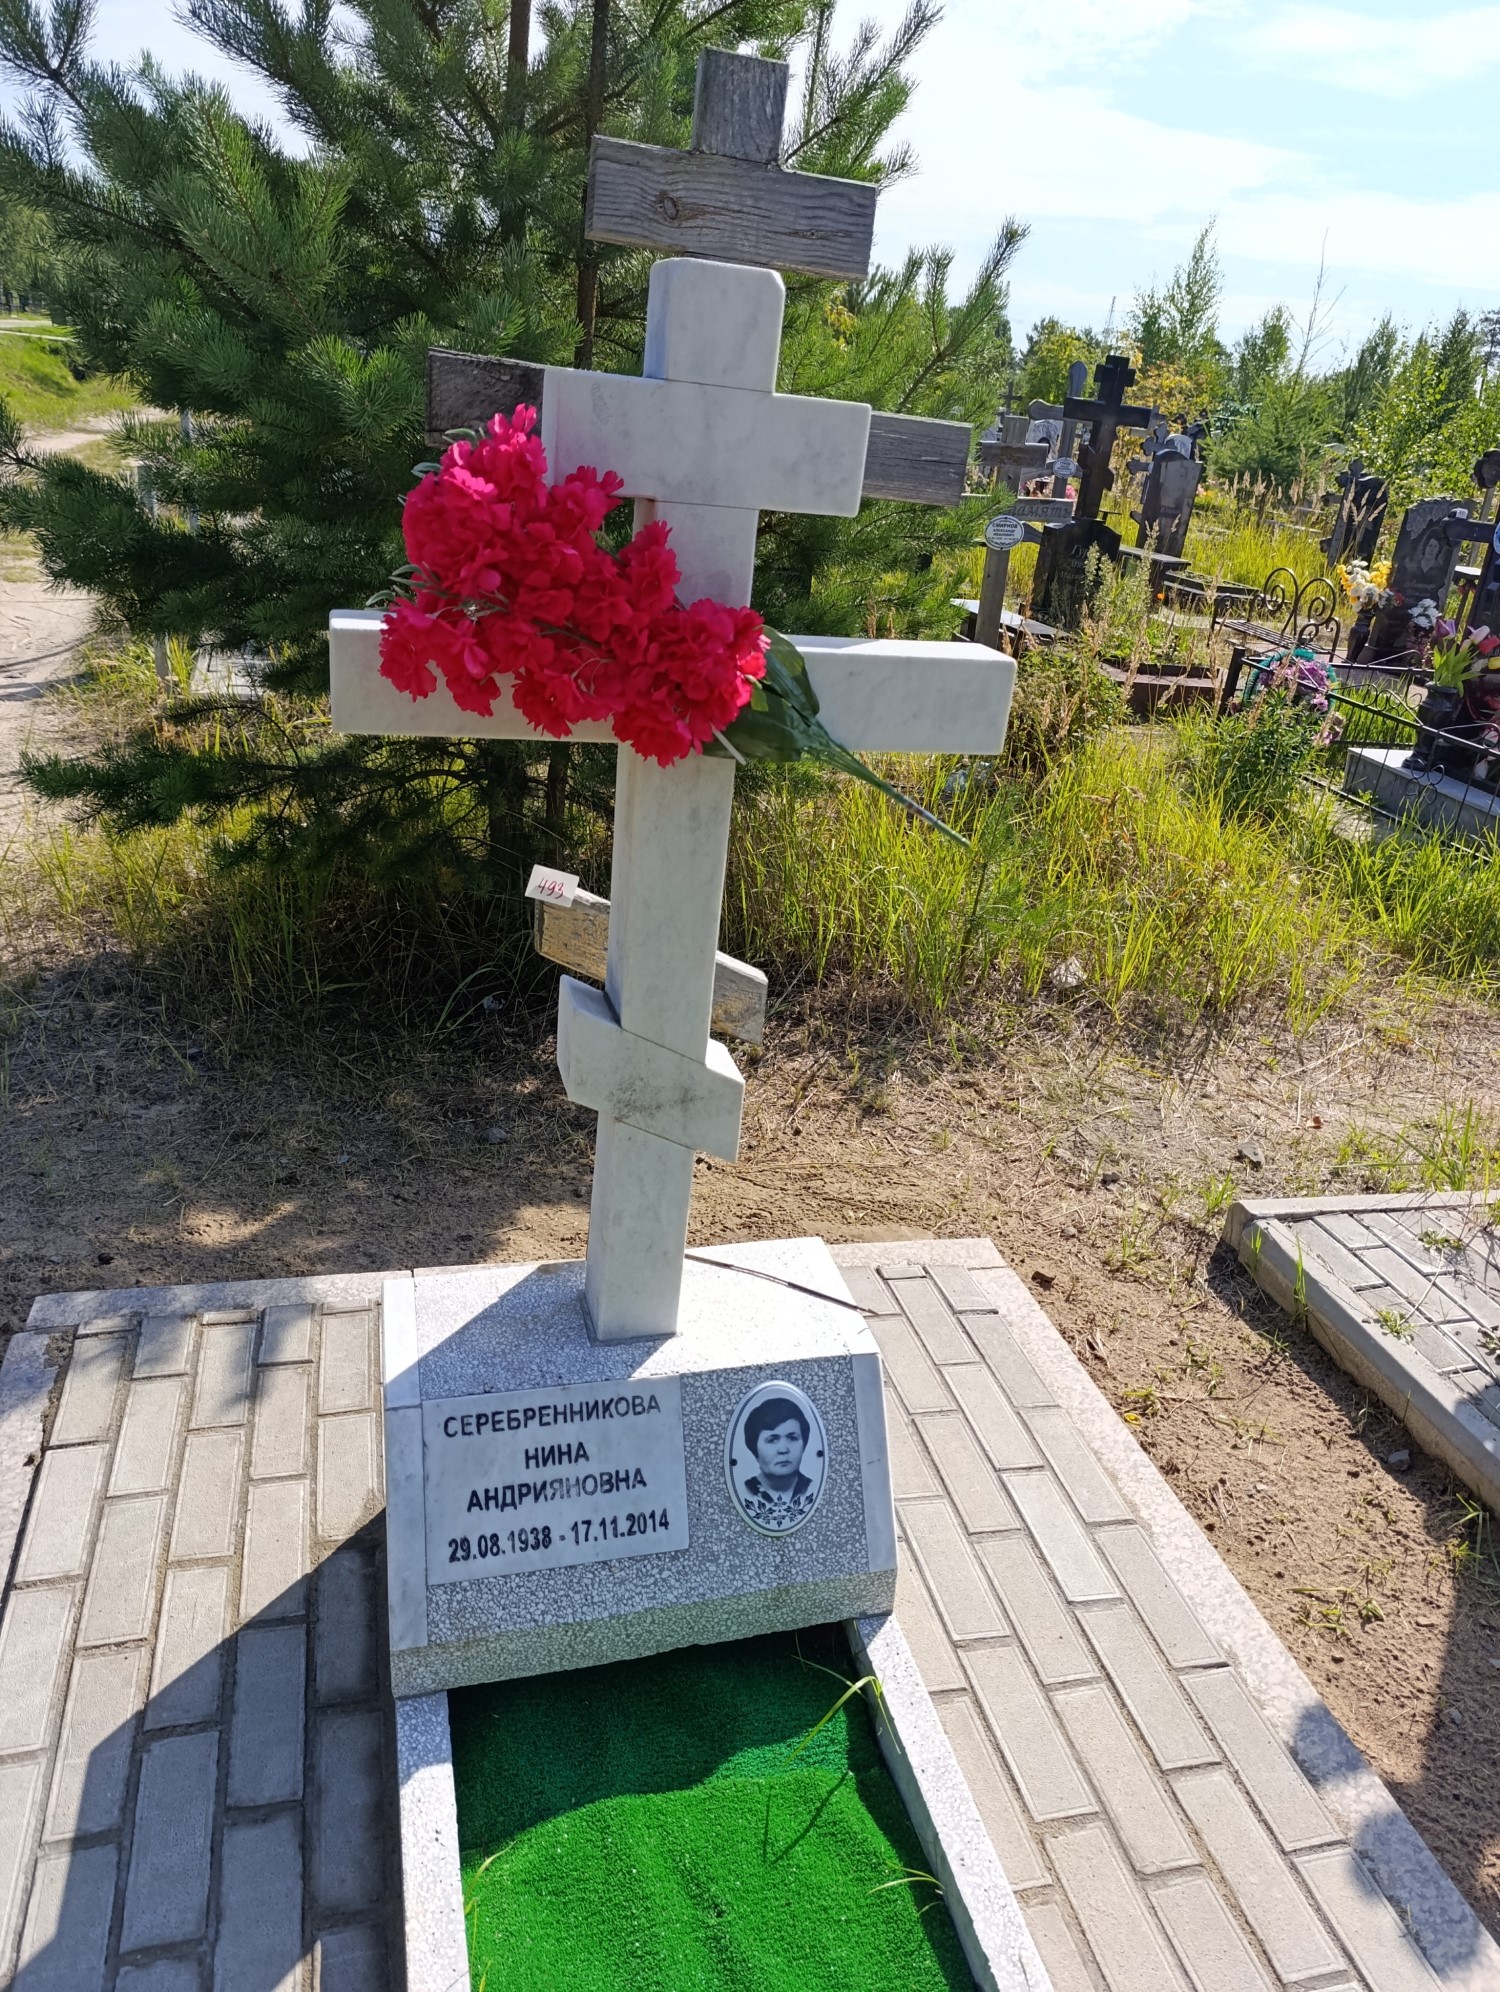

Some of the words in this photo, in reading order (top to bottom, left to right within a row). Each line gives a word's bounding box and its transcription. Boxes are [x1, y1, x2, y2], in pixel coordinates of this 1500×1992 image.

[537, 877, 564, 899] 493
[443, 1394, 661, 1438] СЕРЕБРЕННИКОВА
[524, 1441, 590, 1470] НИНА
[467, 1467, 647, 1512] АНДРИЯНОВНА
[448, 1525, 552, 1563] 29.08.1938
[571, 1508, 669, 1546] 17.11.2014
